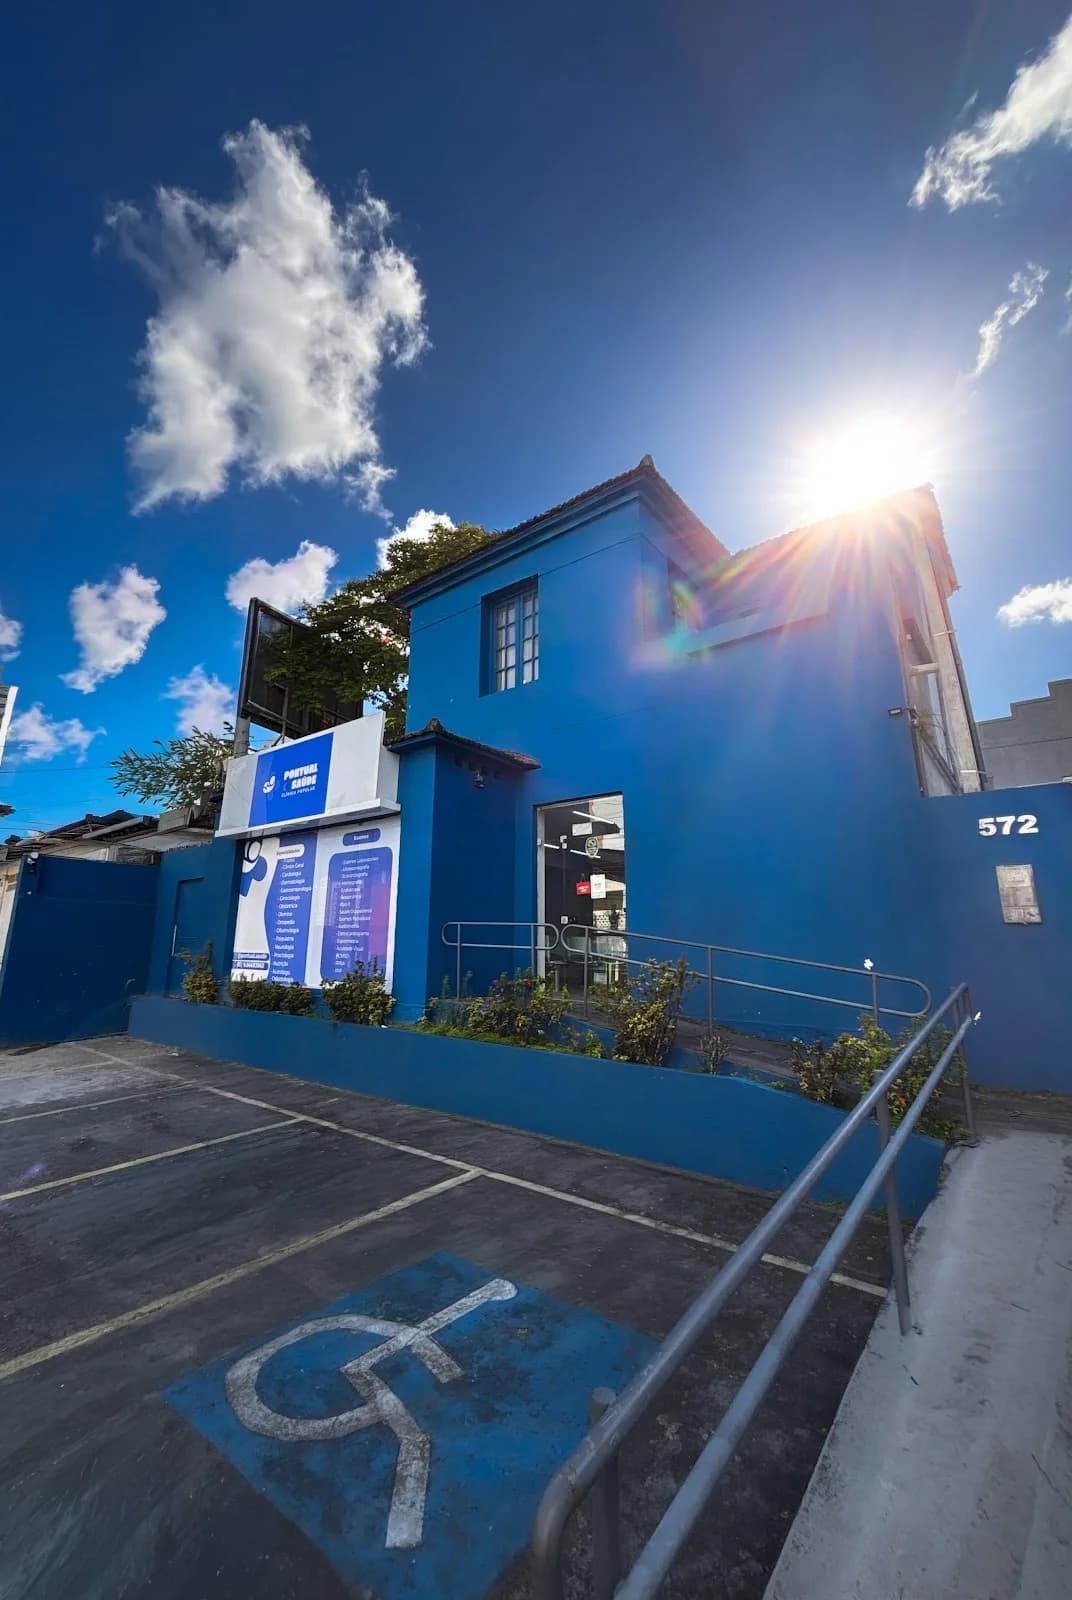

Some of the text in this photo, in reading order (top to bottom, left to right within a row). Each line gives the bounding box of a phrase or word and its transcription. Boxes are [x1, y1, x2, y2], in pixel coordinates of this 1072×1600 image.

[283, 763, 318, 781] PONTUAL
[291, 774, 318, 790] SAÚDE
[978, 814, 1039, 837] 572
